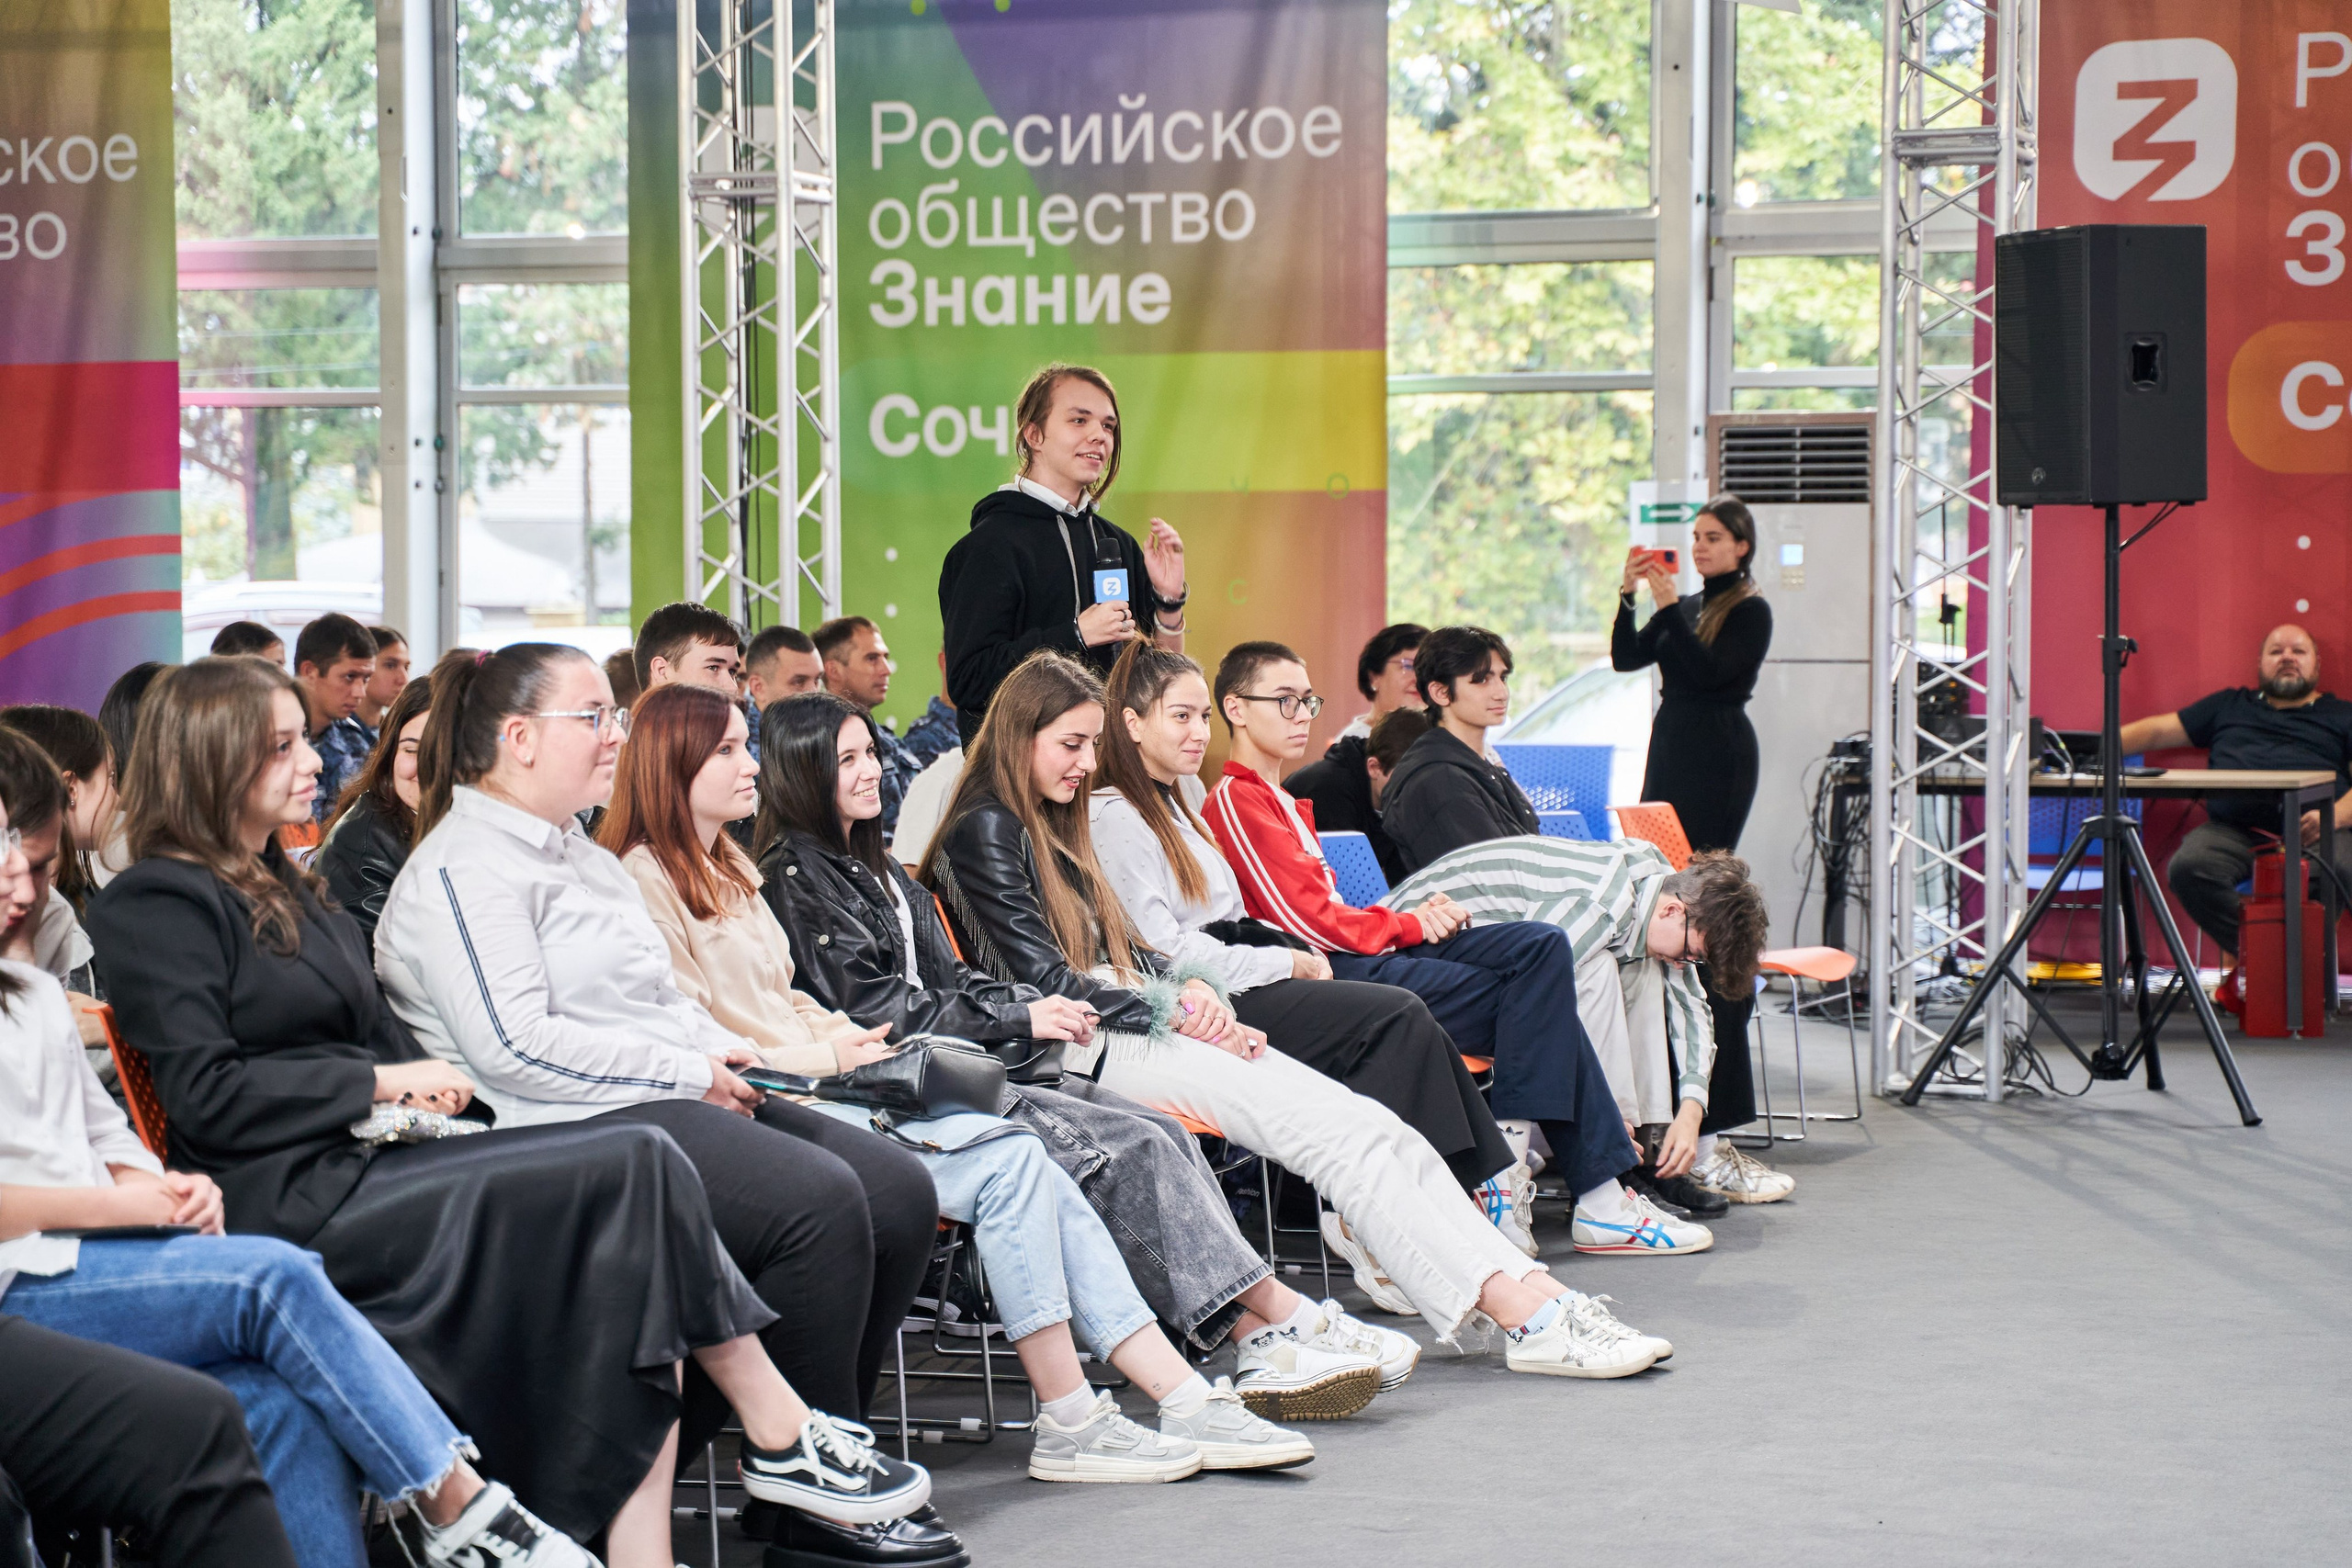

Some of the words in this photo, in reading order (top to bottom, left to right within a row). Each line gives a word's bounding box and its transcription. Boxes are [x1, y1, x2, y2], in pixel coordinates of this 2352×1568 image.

[870, 93, 1342, 171] Российское
[868, 178, 1257, 258] общество
[868, 258, 1172, 328] Знание
[868, 393, 1009, 457] Соч
[2280, 360, 2352, 432] С
